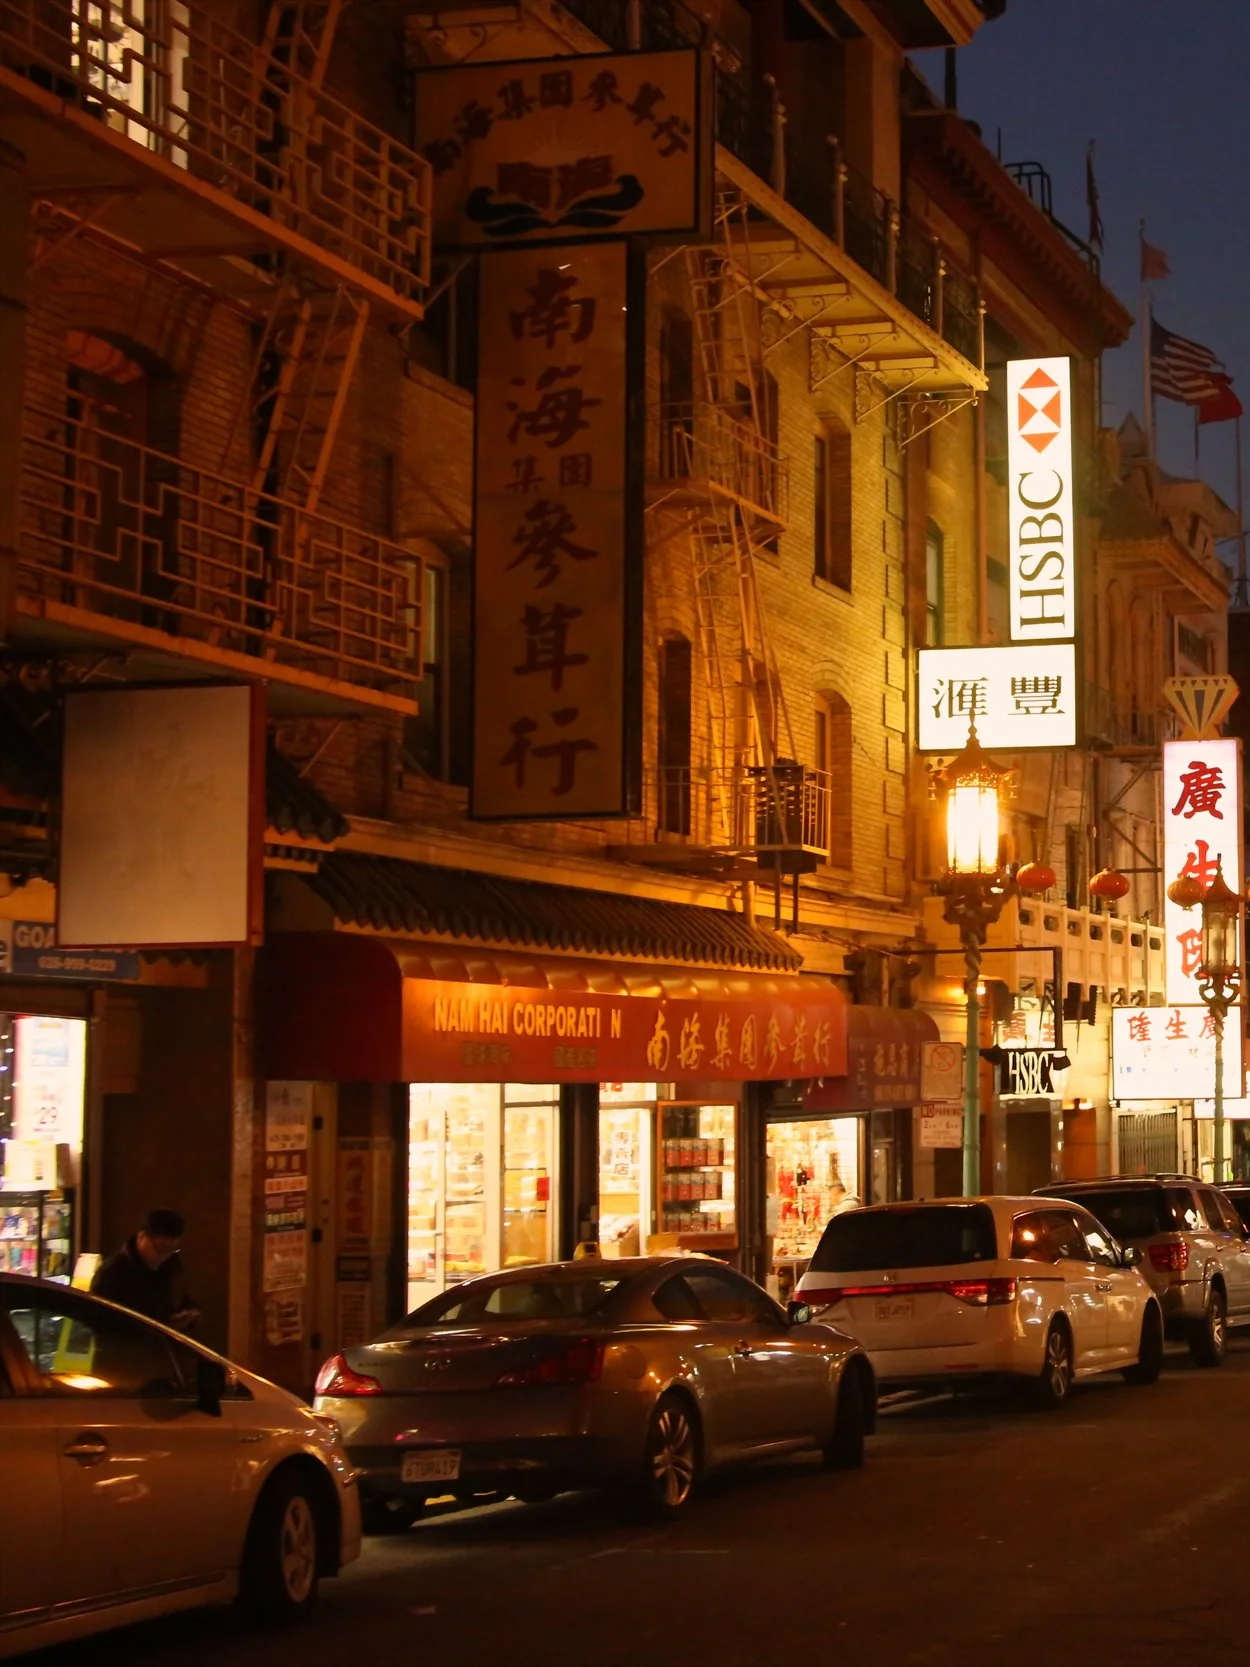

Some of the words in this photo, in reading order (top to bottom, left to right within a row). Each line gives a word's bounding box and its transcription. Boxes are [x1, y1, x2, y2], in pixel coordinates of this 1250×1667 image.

[1018, 468, 1066, 630] HSBC
[931, 675, 1066, 719] 滙豐
[434, 997, 473, 1032] NAM
[479, 1000, 508, 1034] HAI
[1008, 1051, 1049, 1095] HSBC
